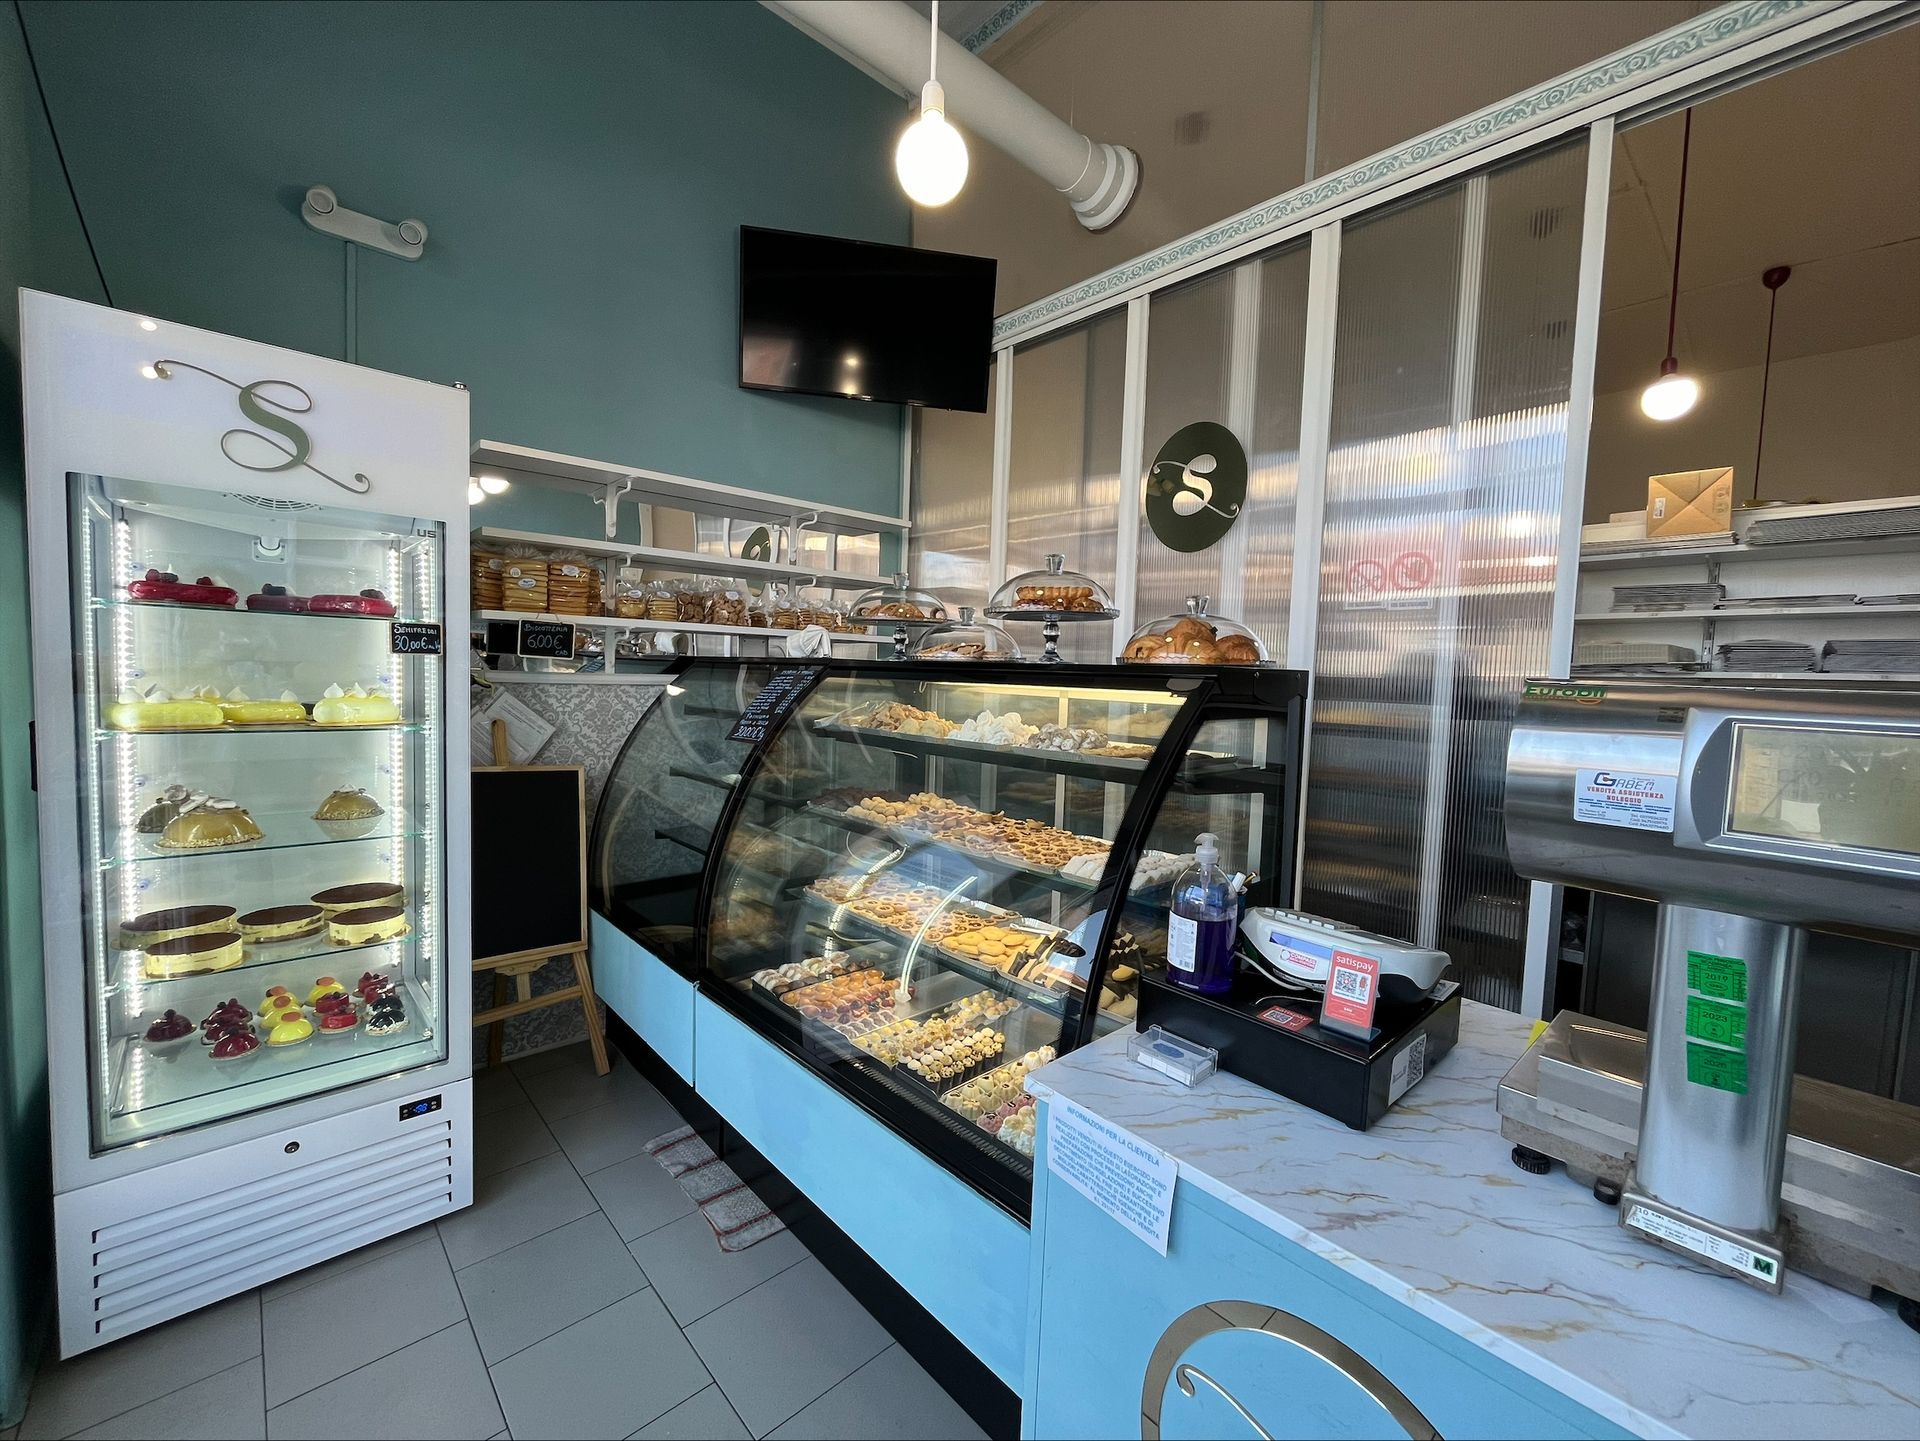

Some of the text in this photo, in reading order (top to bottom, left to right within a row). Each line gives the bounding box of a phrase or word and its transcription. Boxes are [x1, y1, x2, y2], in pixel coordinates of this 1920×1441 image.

[1586, 786, 1664, 800] VENDITA ASSISTENZA
[1336, 954, 1374, 973] satispay
[1705, 972, 1728, 983] 2019
[1702, 1011, 1728, 1022] 2023
[1066, 1105, 1160, 1167] INFORMAZIONI PER LA CLIENTELA
